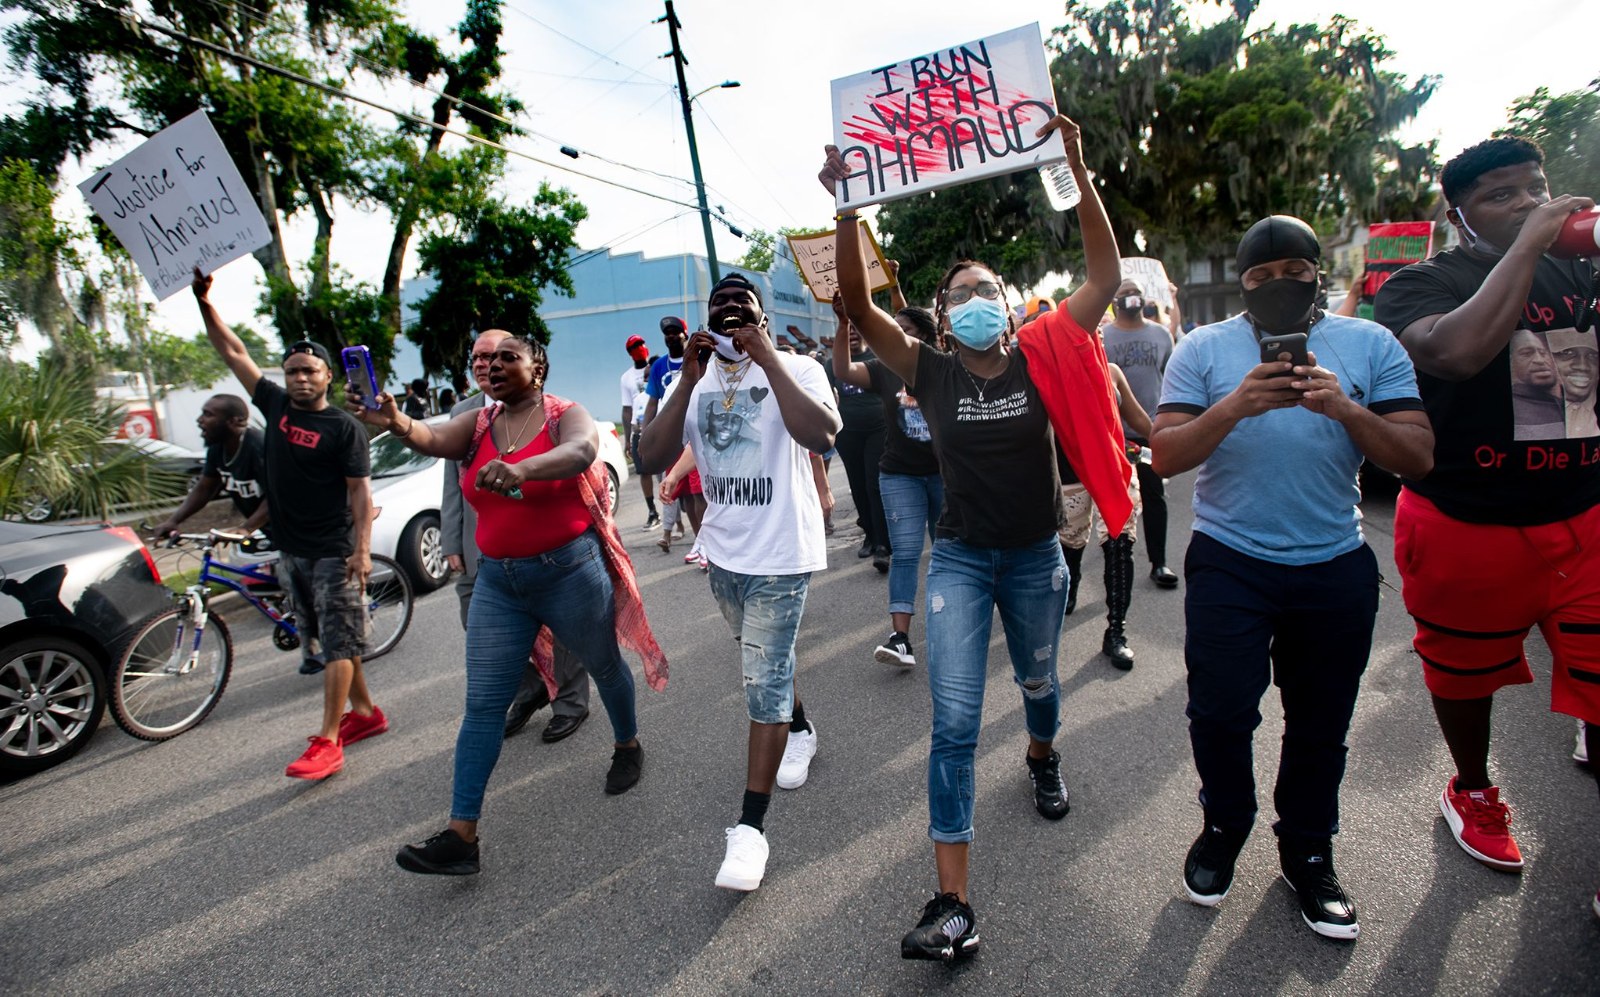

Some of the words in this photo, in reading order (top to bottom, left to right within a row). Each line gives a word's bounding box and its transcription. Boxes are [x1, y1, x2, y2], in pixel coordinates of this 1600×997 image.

[871, 64, 904, 98] I
[910, 40, 992, 88] RUN
[869, 70, 1000, 135] WITH
[840, 100, 1057, 203] AHMAUD
[90, 167, 175, 219] Justice
[175, 147, 206, 176] for
[138, 176, 241, 266] Ahmaud
[1523, 302, 1555, 327] Up
[1113, 340, 1159, 356] WATCH
[1475, 445, 1507, 468] Or
[1526, 446, 1569, 470] Die
